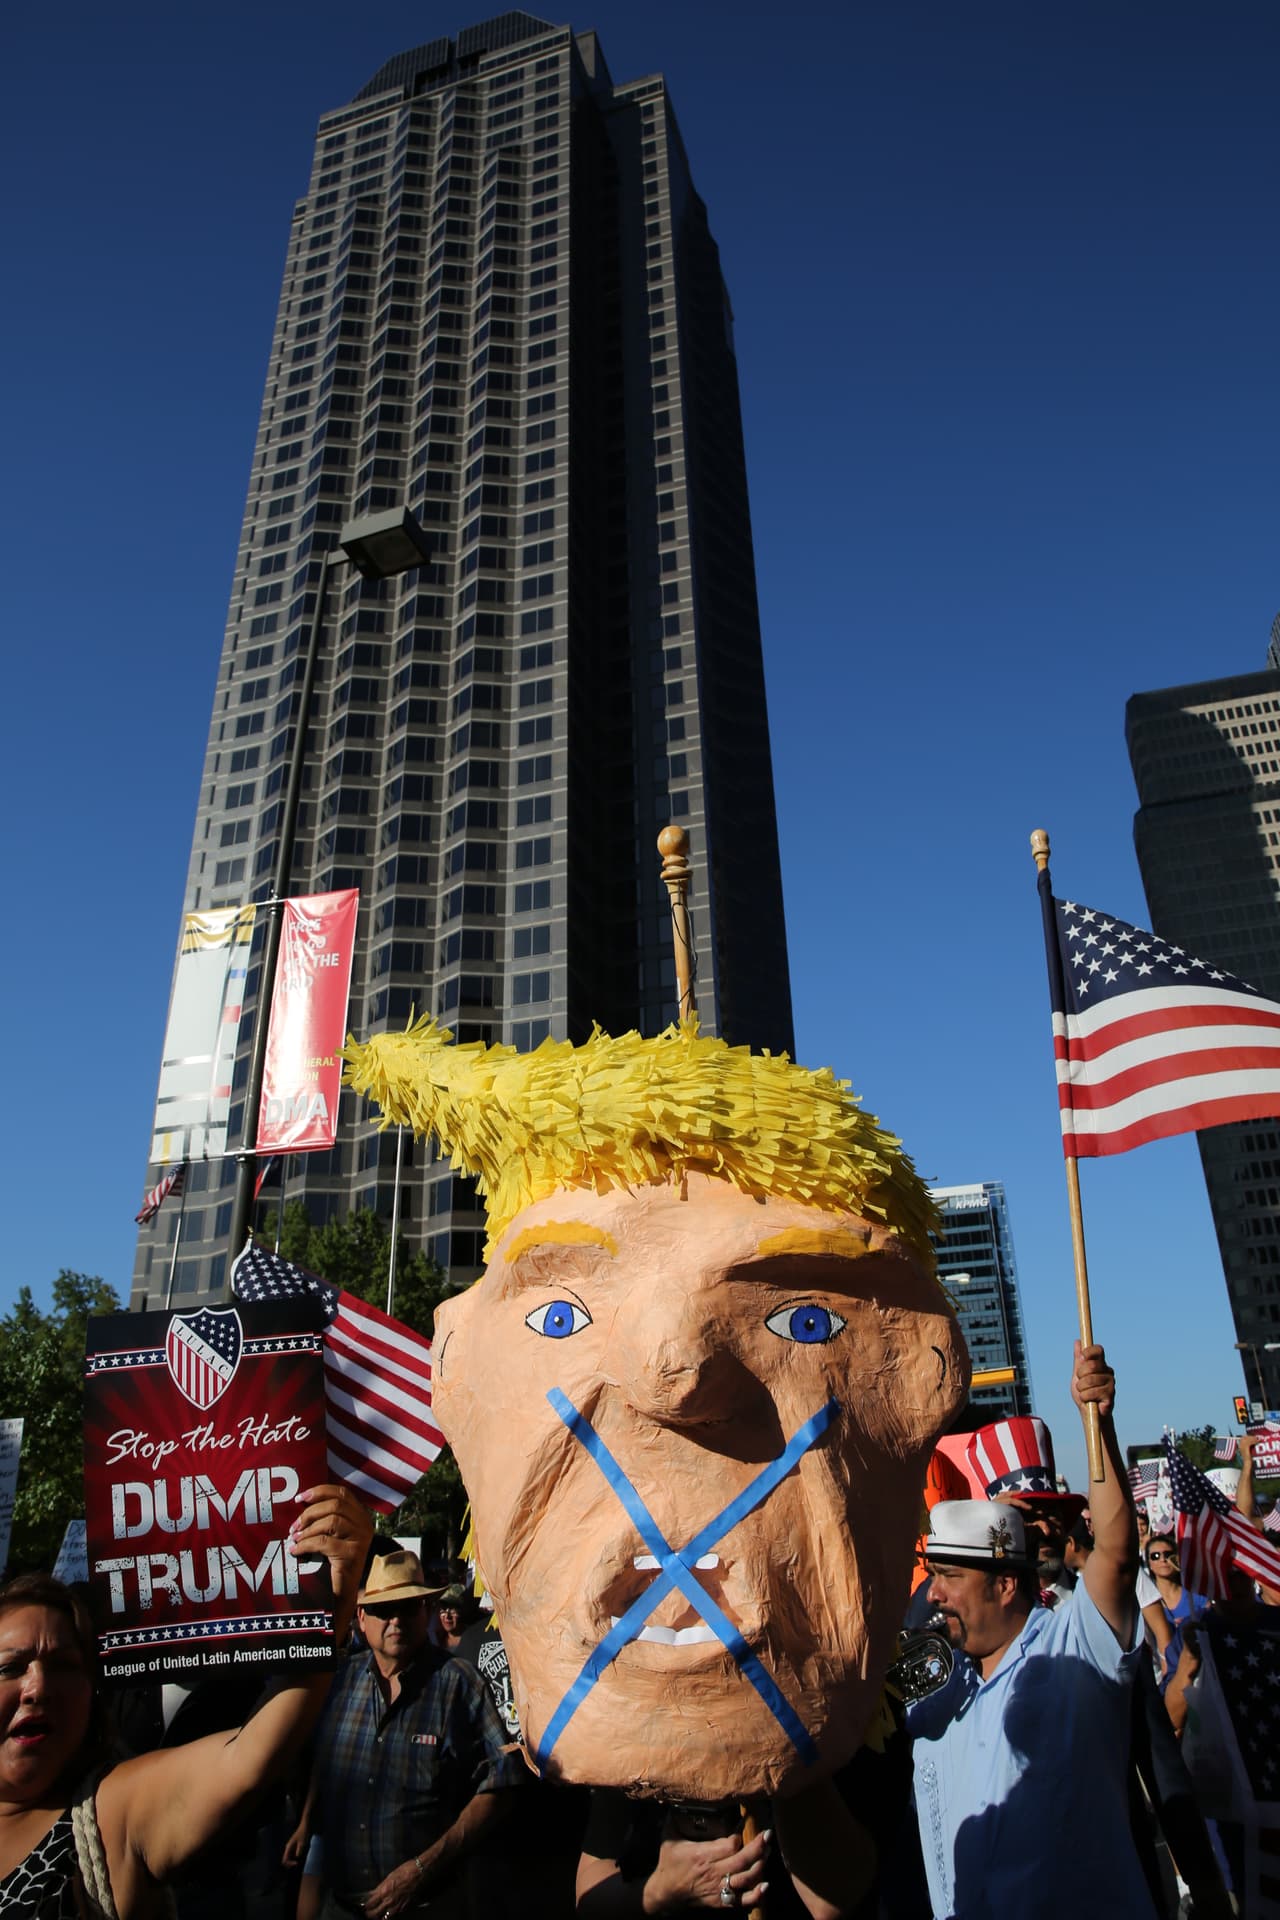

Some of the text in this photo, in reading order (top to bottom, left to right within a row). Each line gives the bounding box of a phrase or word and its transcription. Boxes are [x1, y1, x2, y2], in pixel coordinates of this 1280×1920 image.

[312, 952, 340, 969] THE
[265, 1092, 329, 1123] DMA
[956, 1198, 988, 1209] KPMG
[175, 1326, 229, 1374] LULAC
[105, 1413, 311, 1470] Stop the Hate
[1255, 1440, 1280, 1454] DU
[111, 1465, 300, 1540] DUMP
[95, 1538, 324, 1614] TRUMP
[103, 1644, 333, 1677] League of United Latin American Citizens
